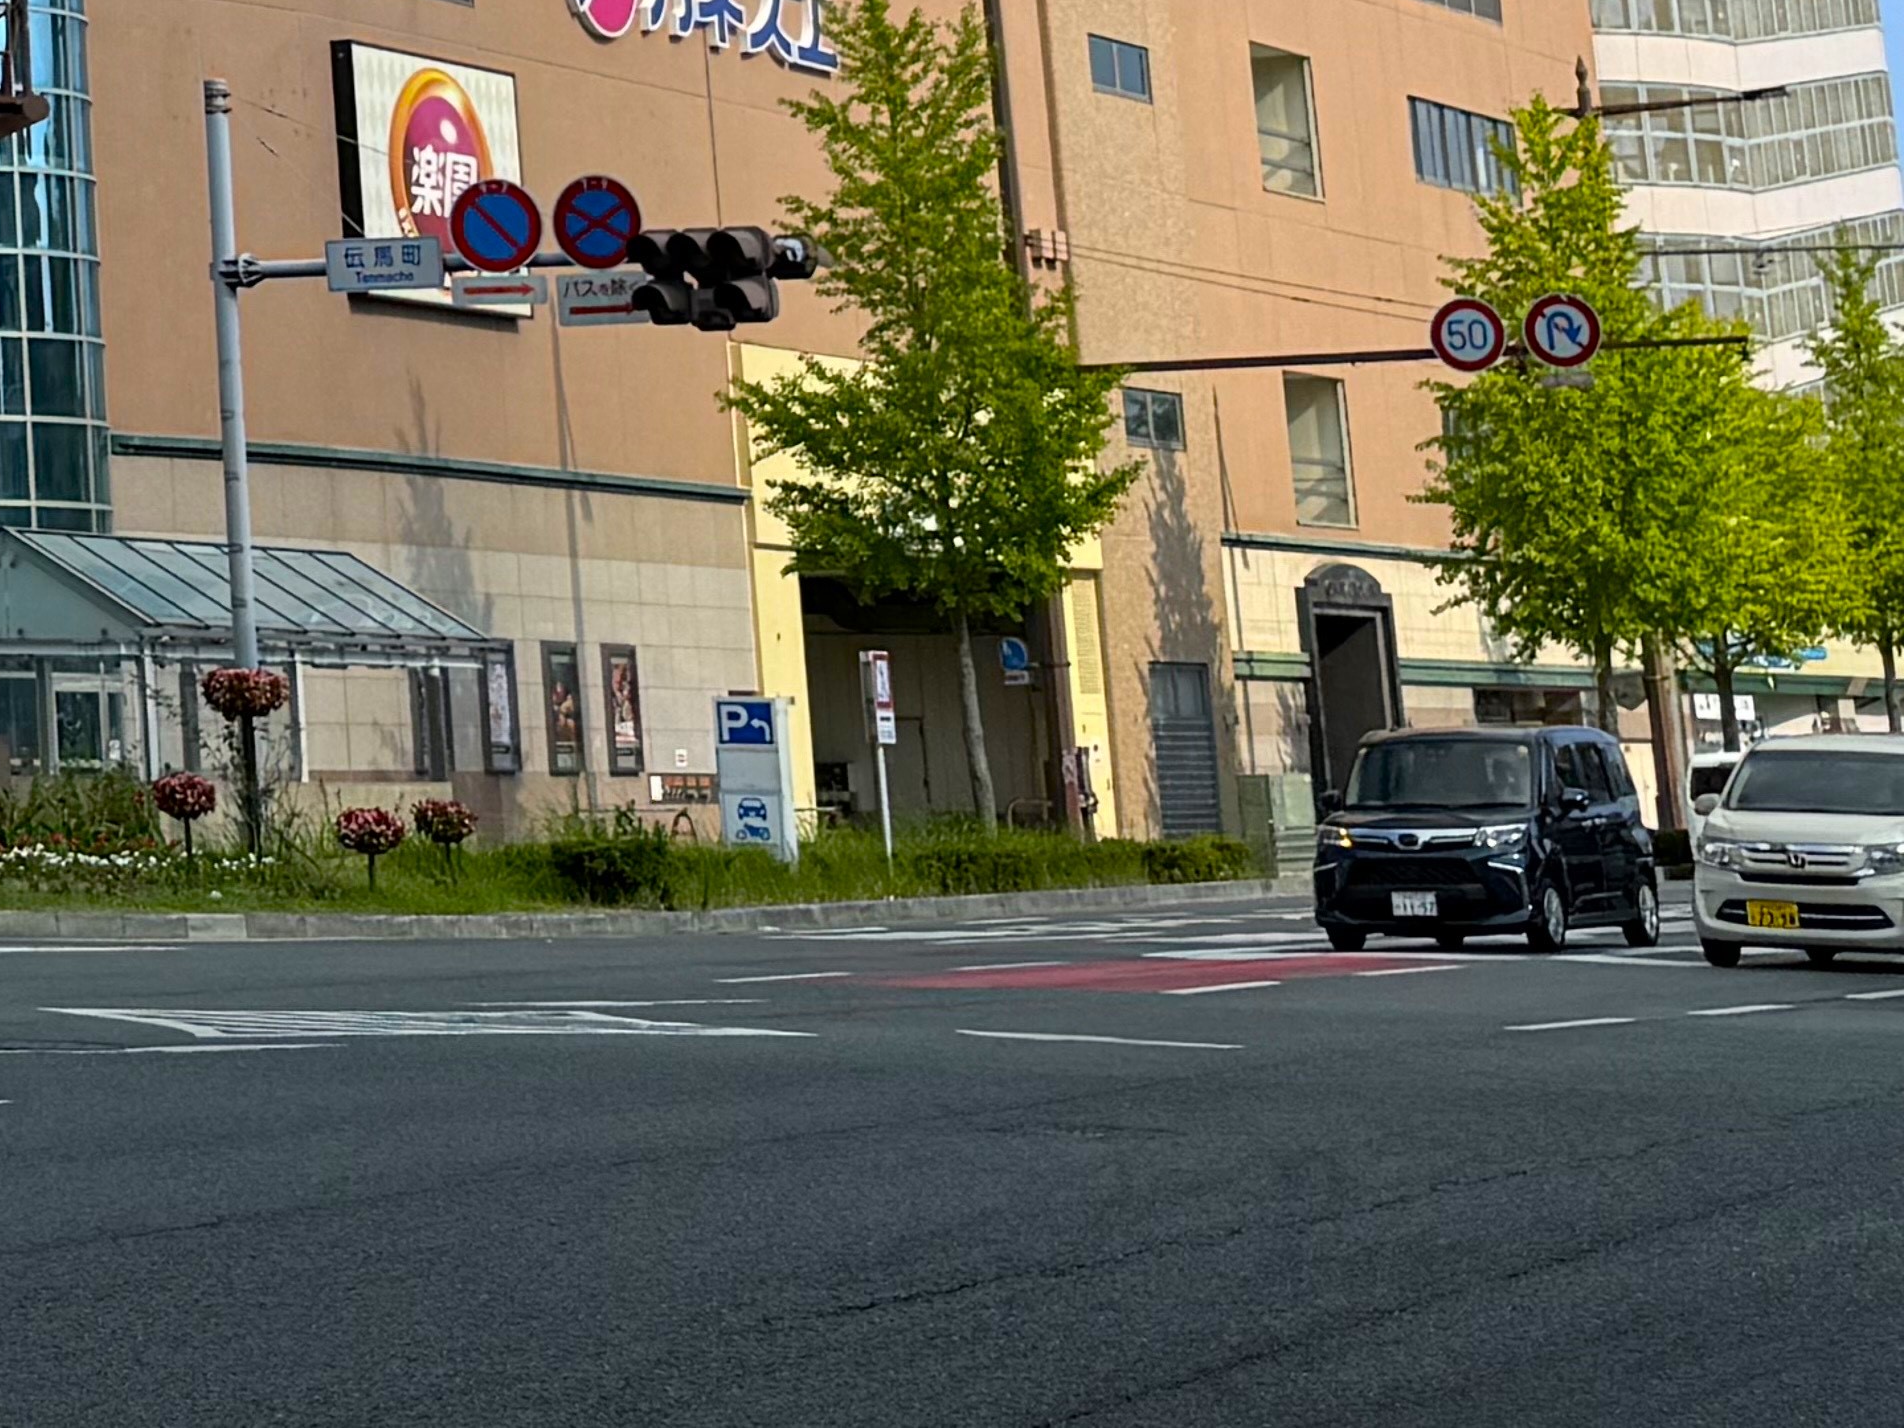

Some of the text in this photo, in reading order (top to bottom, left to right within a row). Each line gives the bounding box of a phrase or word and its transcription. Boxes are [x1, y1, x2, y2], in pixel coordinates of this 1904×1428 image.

[344, 245, 421, 268] 伝馬町
[355, 271, 414, 283] Tenmacho
[1447, 319, 1488, 351] 50
[719, 704, 748, 742] P
